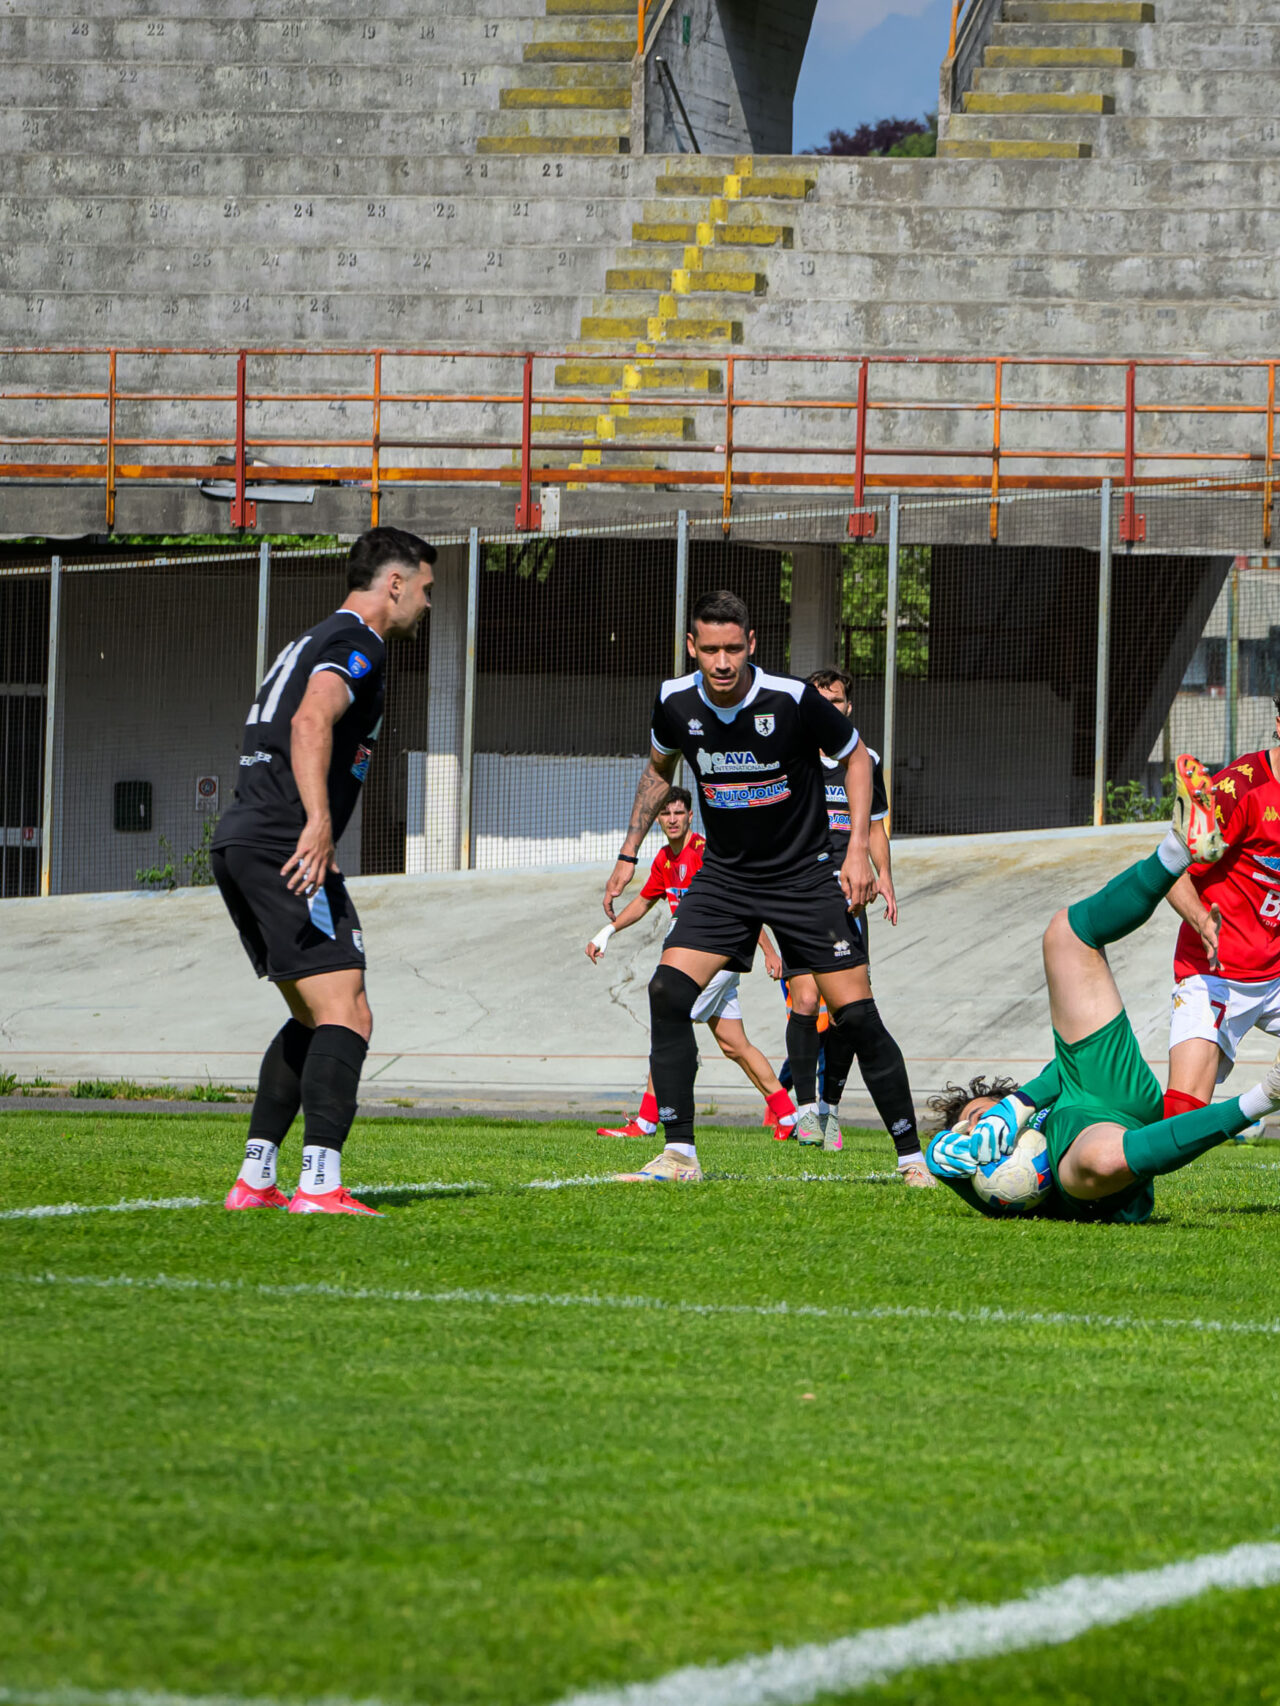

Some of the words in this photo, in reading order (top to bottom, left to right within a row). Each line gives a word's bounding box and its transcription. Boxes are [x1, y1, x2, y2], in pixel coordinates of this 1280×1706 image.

[147, 24, 164, 36] 22
[361, 24, 376, 39] 19
[419, 26, 435, 39] 18
[484, 24, 499, 38] 17
[119, 71, 137, 83] 22
[461, 72, 477, 86] 17
[294, 203, 313, 217] 24
[367, 203, 386, 217] 23
[513, 203, 529, 217] 21
[338, 253, 357, 267] 23
[487, 252, 503, 267] 21
[799, 260, 815, 275] 19
[310, 299, 330, 313] 23
[465, 299, 484, 313] 21
[711, 752, 757, 765] CAVA
[715, 781, 787, 800] AUTOJOLLY
[1211, 1000, 1226, 1029] 7
